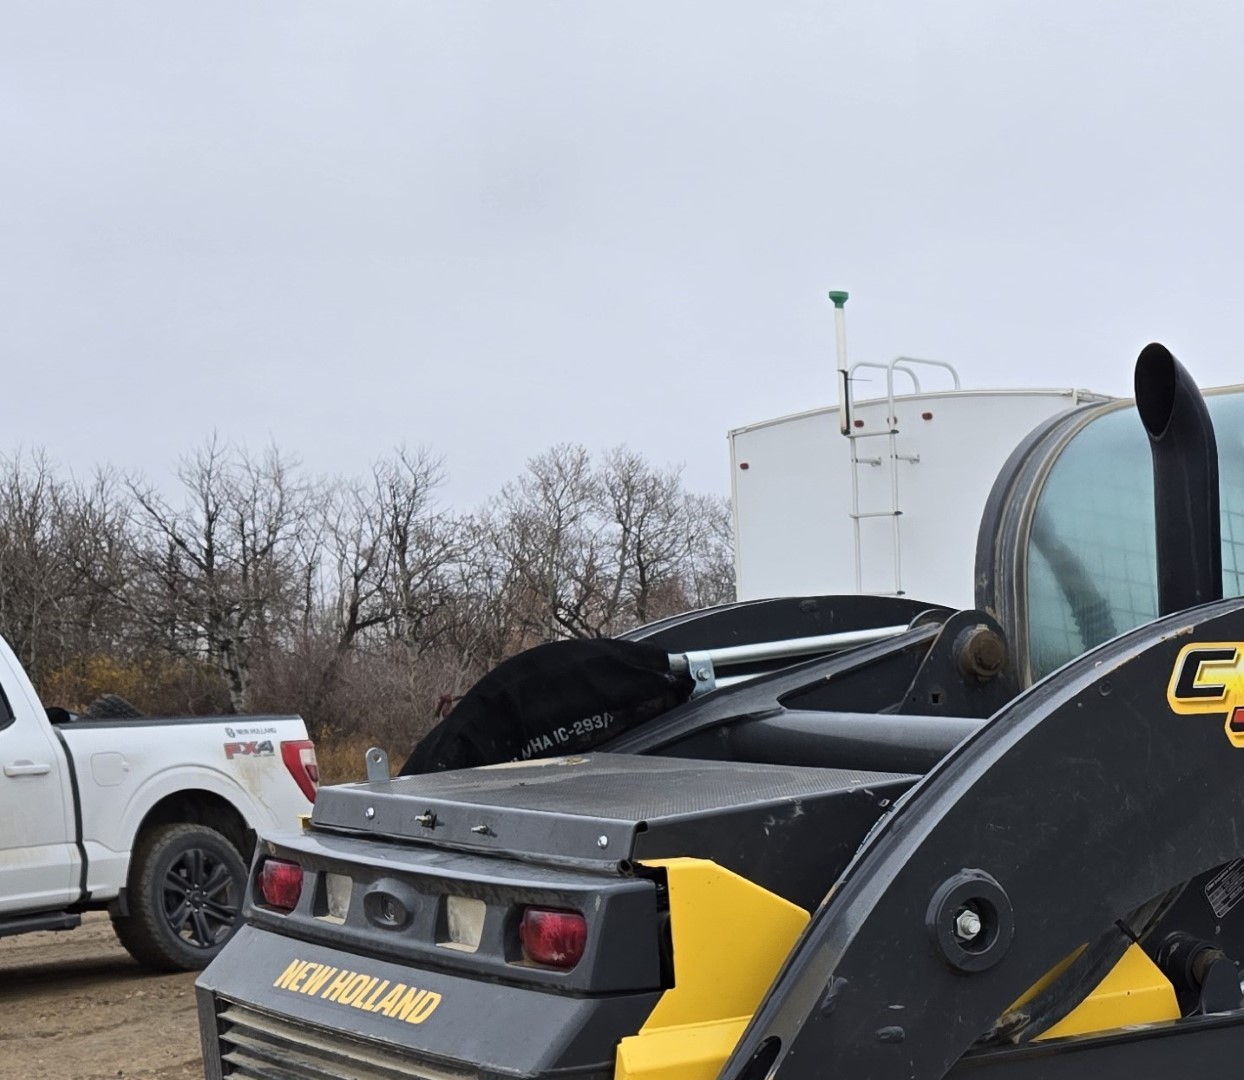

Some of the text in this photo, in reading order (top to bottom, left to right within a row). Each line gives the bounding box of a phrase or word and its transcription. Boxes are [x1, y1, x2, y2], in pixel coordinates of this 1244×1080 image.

[223, 740, 275, 759] FX4
[272, 958, 442, 1025] NEW HOLLAND
